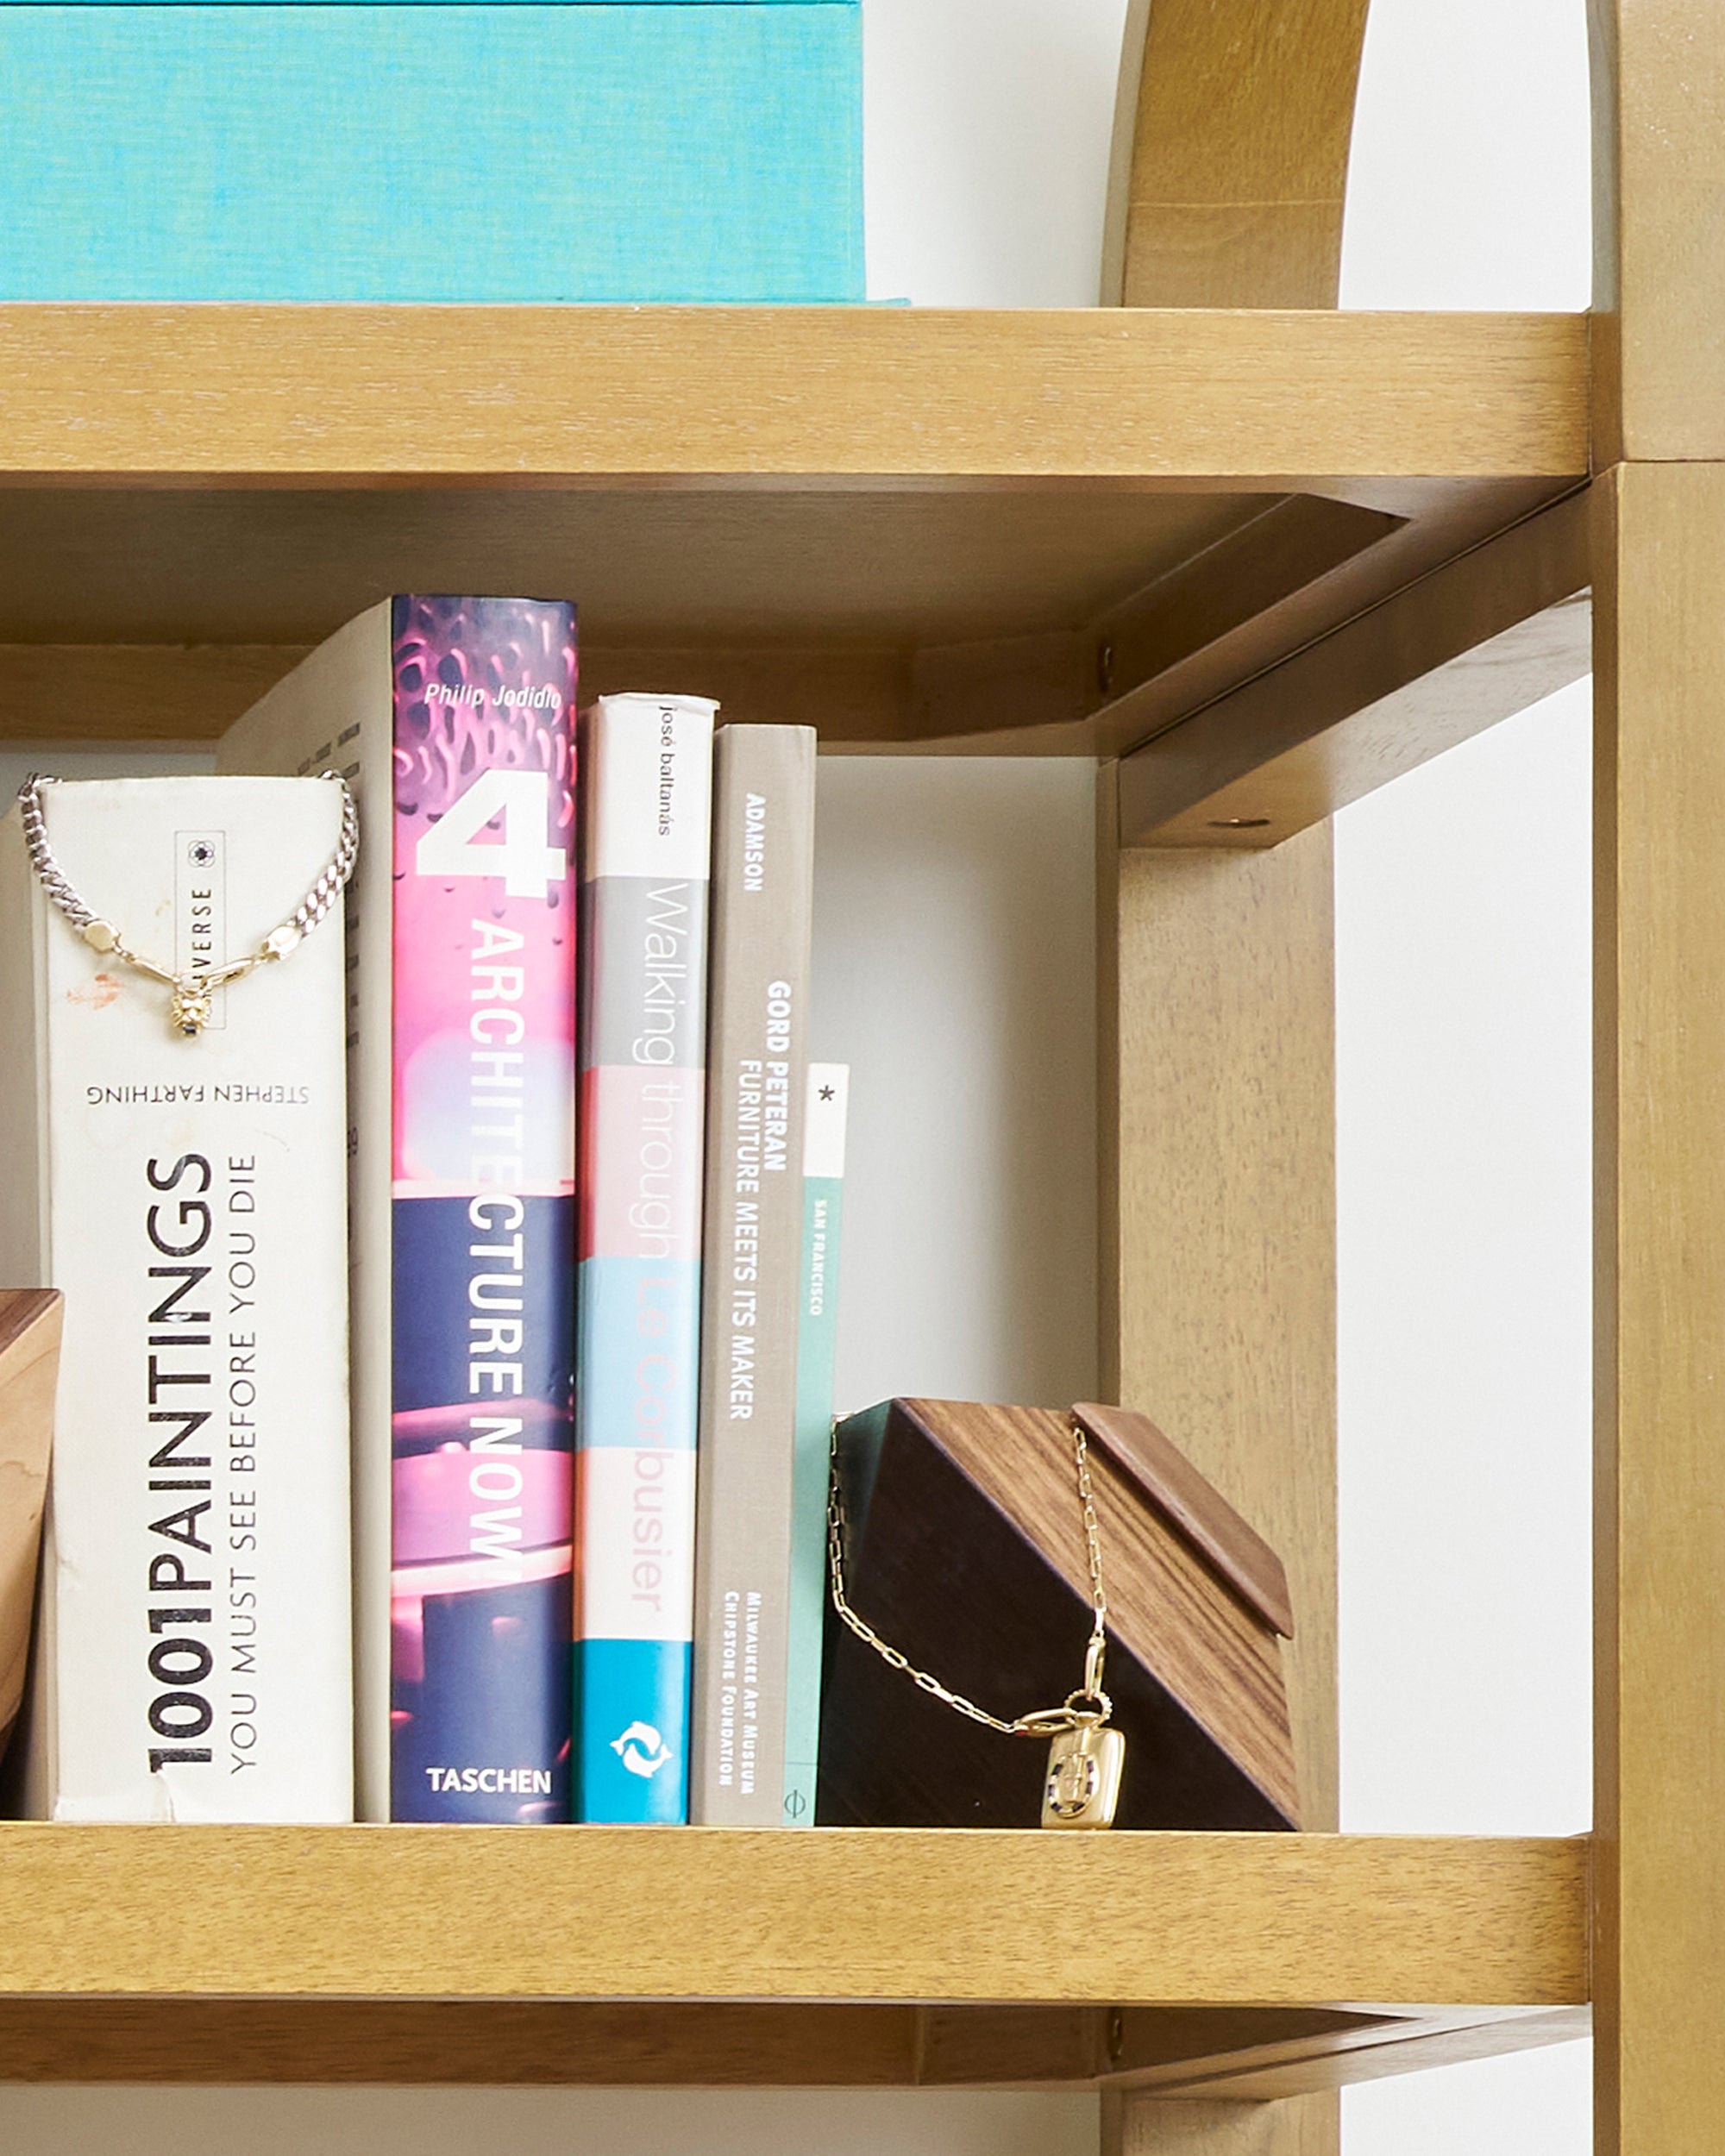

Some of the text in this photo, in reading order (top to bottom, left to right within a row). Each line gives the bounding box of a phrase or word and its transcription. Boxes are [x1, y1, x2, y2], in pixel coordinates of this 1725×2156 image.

[423, 683, 562, 709] Philip Jodidio
[416, 769, 566, 899] 4
[658, 753, 675, 837] baltanás
[744, 793, 767, 892] ADAMSON
[86, 1084, 310, 1105] STEPHEN FARTHING
[764, 981, 792, 1171] GORD PETERAN
[468, 918, 524, 1582] ARCHITECTURE NOW
[628, 882, 689, 1613] Walking through Le Corbusier
[730, 1060, 762, 1420] FURNITURE MEETS ITS MAKER
[809, 1200, 828, 1317] SAN FRANCISCO
[228, 1155, 257, 1775] YOU MUST SEE BEFORE YOU DIE
[425, 1767, 552, 1794] TASCHEN
